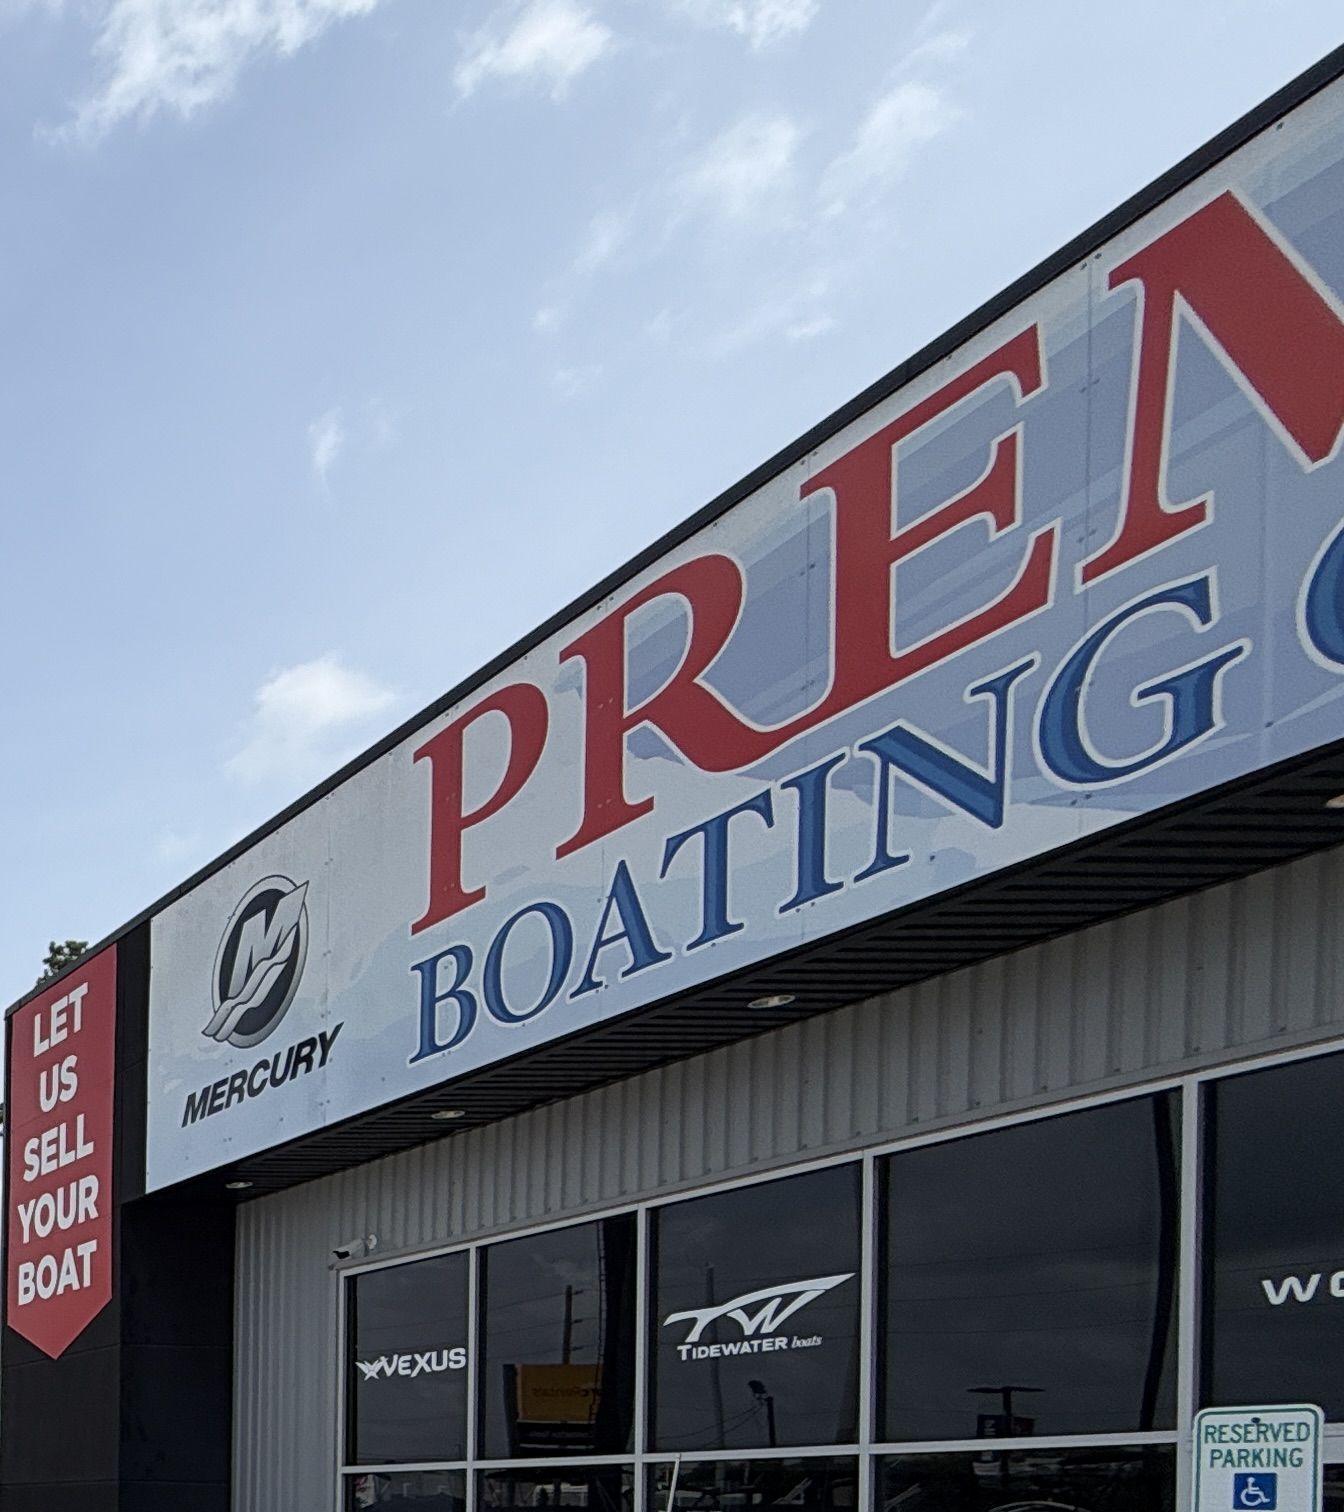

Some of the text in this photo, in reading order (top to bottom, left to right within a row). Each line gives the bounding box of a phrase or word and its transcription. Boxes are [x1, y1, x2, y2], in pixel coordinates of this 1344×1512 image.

[408, 572, 1249, 1065] BOATING
[33, 982, 89, 1058] LET
[40, 1054, 78, 1113] US
[181, 1021, 345, 1128] MERCURY
[23, 1113, 94, 1183] SELL
[18, 1174, 100, 1244] YOUR
[18, 1239, 98, 1306] BOAT
[379, 1348, 466, 1378] VEXUS
[677, 1335, 823, 1361] TIDEWATER boats
[1204, 1422, 1311, 1444] RESERVED
[1209, 1447, 1304, 1468] PARKING
